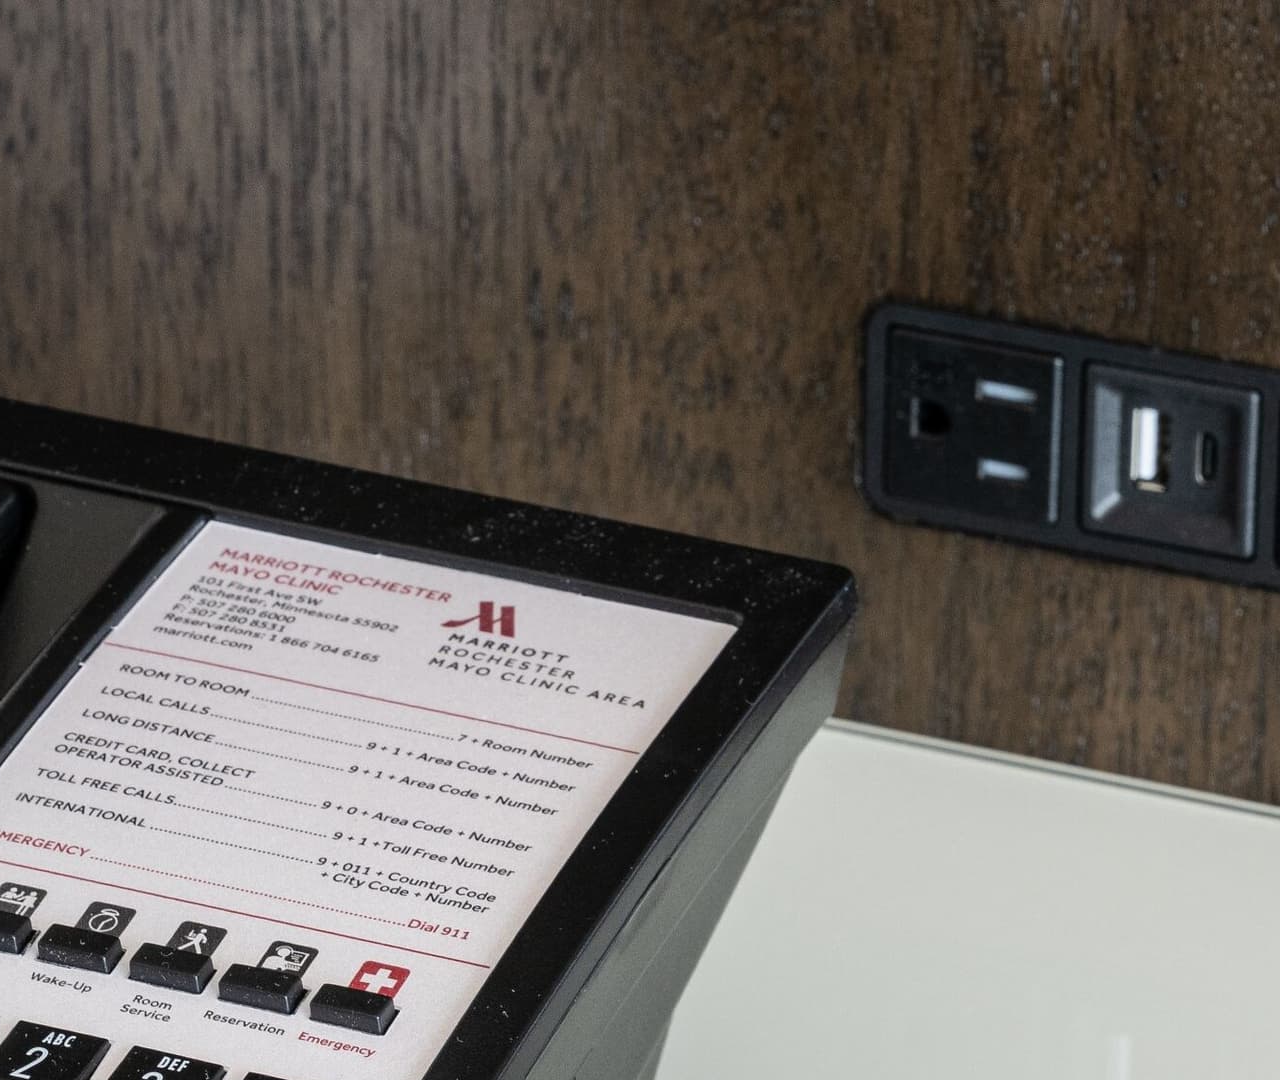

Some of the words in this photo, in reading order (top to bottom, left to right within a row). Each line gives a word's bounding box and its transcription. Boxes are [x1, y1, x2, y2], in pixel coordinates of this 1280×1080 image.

[198, 576, 224, 586] 101
[227, 580, 262, 594] First
[263, 589, 293, 600] Ave
[296, 595, 323, 606] SW
[208, 561, 270, 580] MAYO
[274, 574, 344, 596] CLINIC
[220, 548, 326, 576] MARRIOTT
[328, 570, 452, 603] ROCHESTER
[188, 608, 217, 618] 507
[218, 613, 248, 624] 280
[189, 584, 267, 607] Rochester,
[272, 601, 349, 622] Minnesota
[352, 617, 398, 632] 55902
[197, 599, 226, 609] 507
[227, 604, 257, 615] 280
[258, 610, 296, 623] 6000
[153, 625, 253, 650] marriott.com
[163, 613, 266, 639] Reservations:
[280, 636, 308, 648] 866
[312, 643, 339, 654] 704
[341, 648, 380, 663] 6165
[448, 633, 570, 663] MARRIOTT
[437, 645, 576, 680] ROCHESTER
[427, 657, 491, 677] MAYO
[500, 672, 580, 695] CLINIC
[587, 690, 646, 710] AREA
[120, 663, 171, 681] ROOM
[173, 674, 197, 686] TO
[199, 680, 251, 697] ROOM
[457, 734, 468, 743] 7
[481, 738, 527, 756] Room
[529, 749, 594, 769] Number
[63, 731, 125, 750] CREDIT
[125, 745, 172, 763] CARD,
[177, 756, 257, 779] COLLECT
[100, 686, 154, 704] LOCAL
[159, 697, 212, 715] CALLS
[366, 742, 377, 751] 9
[392, 747, 401, 756] 1
[416, 752, 453, 767] Area
[456, 760, 497, 776] Code
[512, 772, 577, 792] Number
[82, 708, 130, 725] LONG
[132, 718, 216, 743] DISTANCE
[347, 765, 359, 774] 9
[374, 771, 383, 779] 1
[398, 776, 435, 790] Area
[439, 784, 479, 800] Code
[494, 795, 559, 816] Number
[54, 744, 143, 769] OPERATOR
[144, 763, 225, 787] ASSISTED
[321, 801, 332, 810] 9
[346, 807, 358, 815] 0
[371, 812, 409, 827] Area
[412, 820, 453, 836] Code
[468, 831, 533, 852] Number
[36, 767, 77, 785] TOLL
[80, 776, 122, 794] FREE
[122, 786, 176, 805] CALLS
[332, 832, 344, 841] 9
[358, 837, 368, 846] 1
[412, 848, 448, 863] Free
[450, 855, 516, 878] Number
[15, 792, 147, 828] INTERNATIONAL
[317, 857, 327, 866] 9
[342, 862, 371, 877] 011
[387, 871, 452, 894] Country
[455, 886, 497, 903] Code
[332, 872, 366, 890] City
[368, 881, 409, 897] Code
[424, 892, 490, 914] Number
[407, 918, 440, 934] Dial
[442, 926, 471, 940] 911
[30, 971, 93, 994] Wake-Up
[120, 1004, 172, 1023] Service
[132, 995, 173, 1011] Room
[41, 1031, 78, 1048] ABC
[203, 1010, 286, 1036] Reservation
[298, 1031, 376, 1058] Emergency
[9, 1046, 49, 1080] 2
[157, 1056, 190, 1073] DEF
